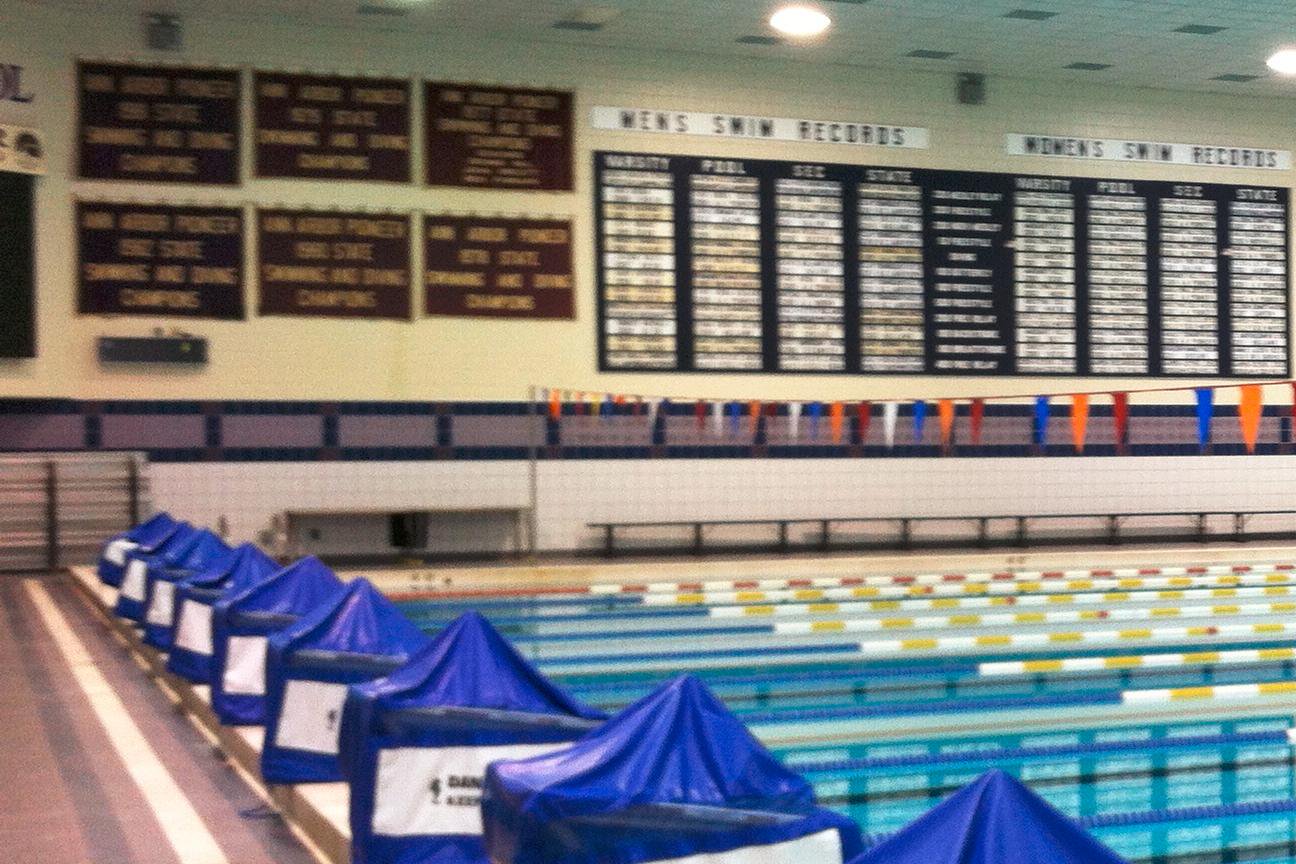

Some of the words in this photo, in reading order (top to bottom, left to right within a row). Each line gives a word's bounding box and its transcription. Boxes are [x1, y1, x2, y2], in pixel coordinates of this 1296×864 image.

[799, 120, 906, 146] RECORDS
[1191, 146, 1278, 168] RECORDS
[865, 169, 914, 184] STATE
[1236, 188, 1279, 202] STATE
